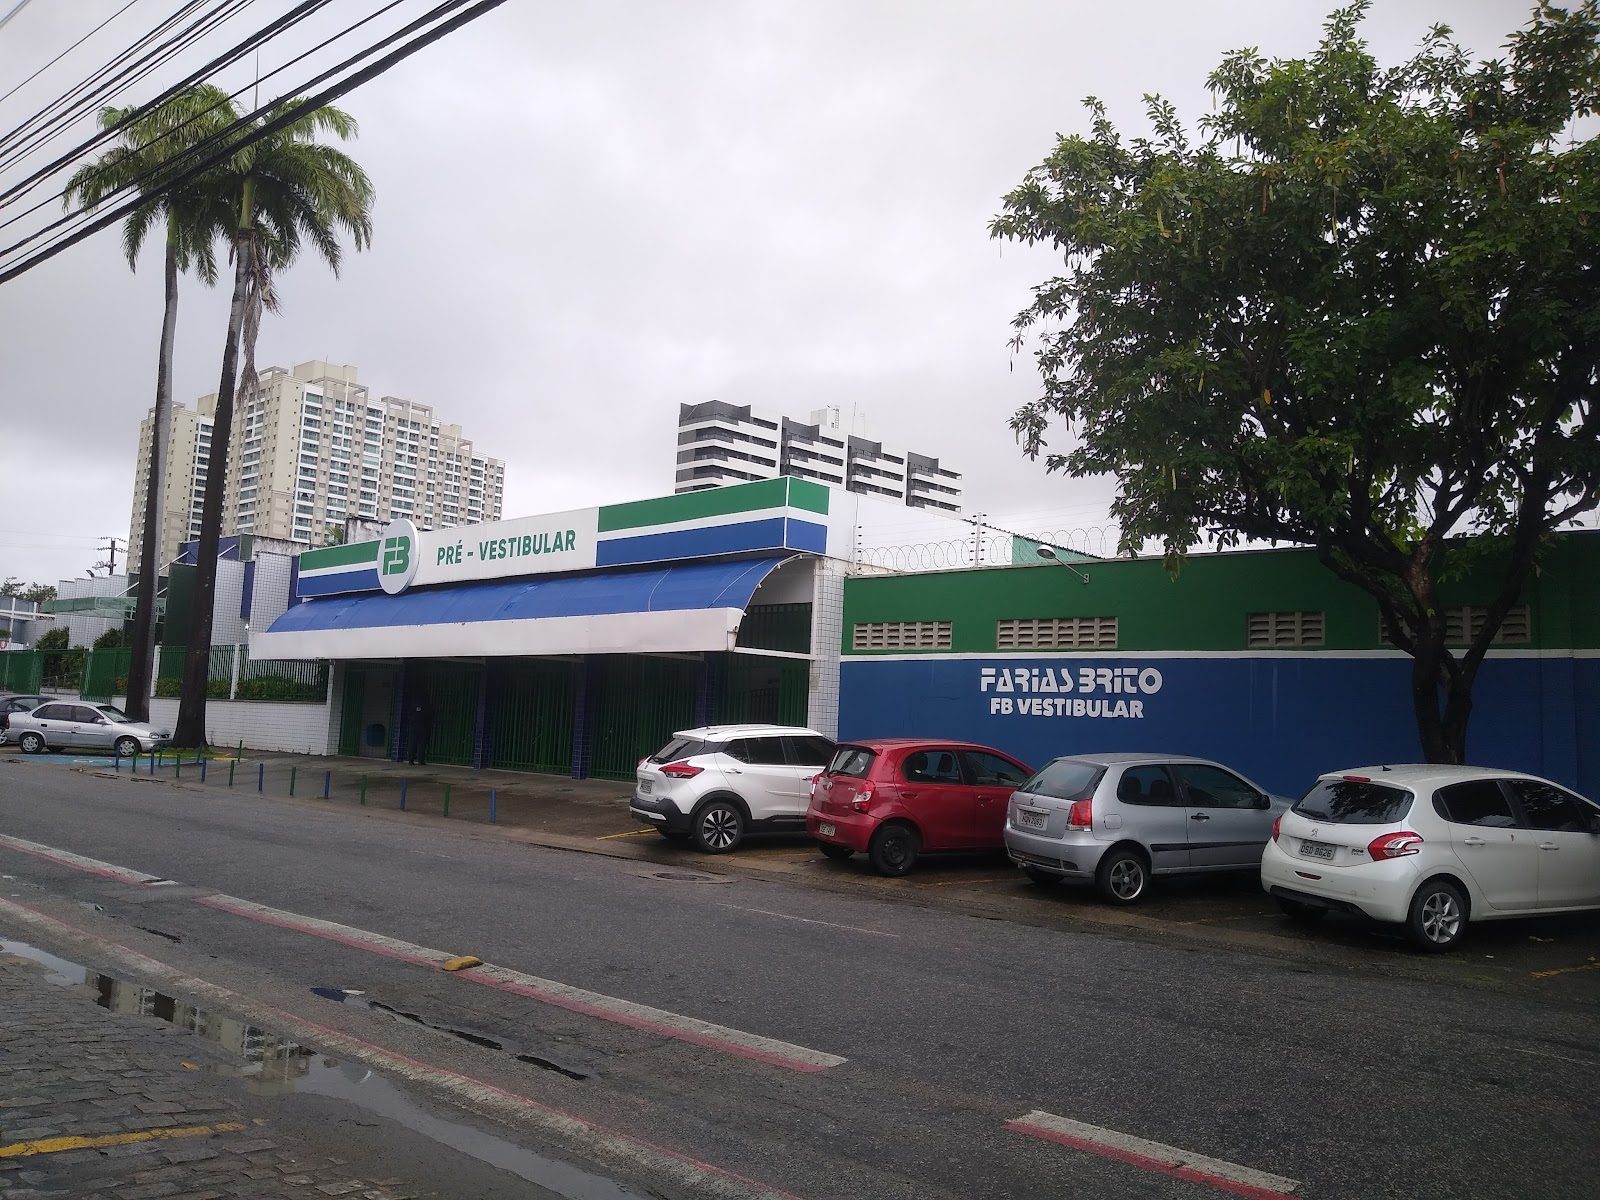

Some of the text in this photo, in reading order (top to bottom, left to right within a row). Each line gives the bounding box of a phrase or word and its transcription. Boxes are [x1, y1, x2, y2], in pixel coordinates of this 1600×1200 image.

[437, 539, 463, 566] PRÉ
[479, 529, 576, 561] VESTIBULAR
[990, 698, 1145, 719] FB VESTIBULAR
